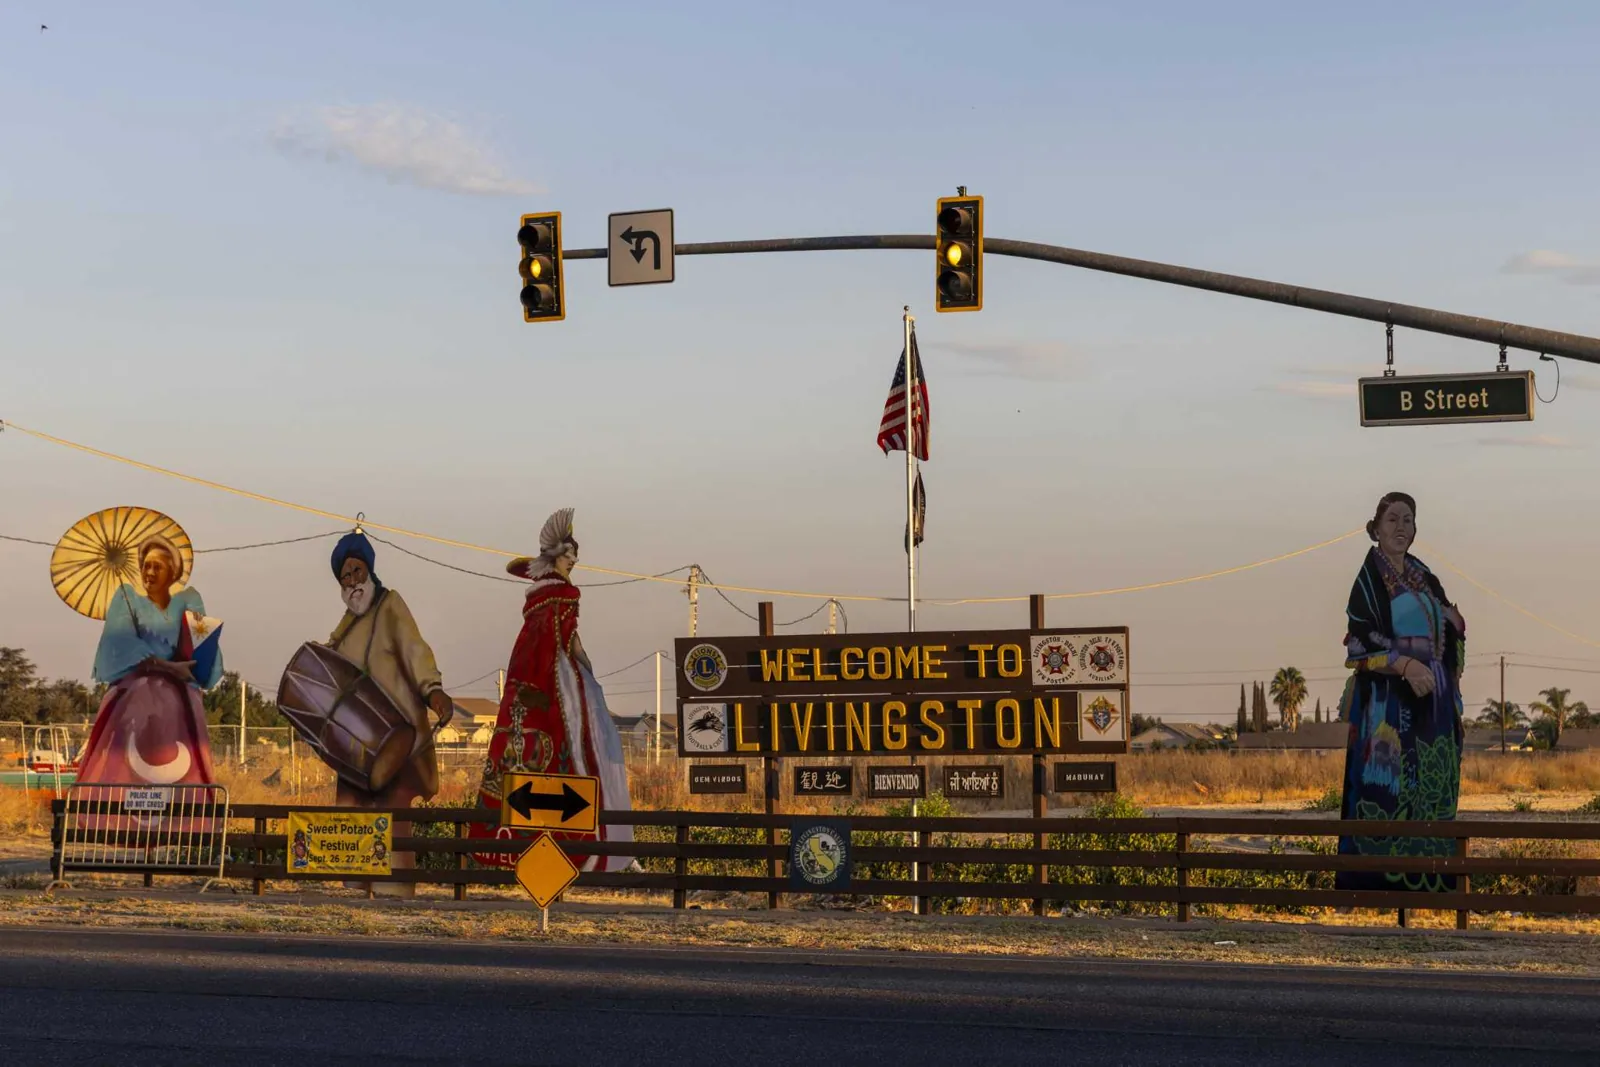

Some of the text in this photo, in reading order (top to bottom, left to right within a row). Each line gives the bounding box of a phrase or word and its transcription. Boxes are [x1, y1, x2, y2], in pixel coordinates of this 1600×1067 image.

[1400, 388, 1488, 411] B Street
[1033, 636, 1060, 658] LIVINGSTON
[1064, 640, 1078, 657] DELHI
[700, 660, 712, 674] L
[760, 645, 947, 682] WELCOME
[968, 644, 1022, 678] TO
[734, 697, 1061, 752] LIVINGSTON
[874, 774, 919, 790] BIENVENIDO
[950, 772, 960, 790] ਜੀ
[1065, 774, 1105, 782] MABUHAY
[307, 823, 374, 834] Sweet Potato
[320, 840, 359, 851] Festival
[330, 855, 340, 863] 26
[346, 855, 355, 863] 27
[361, 855, 370, 863] 28
